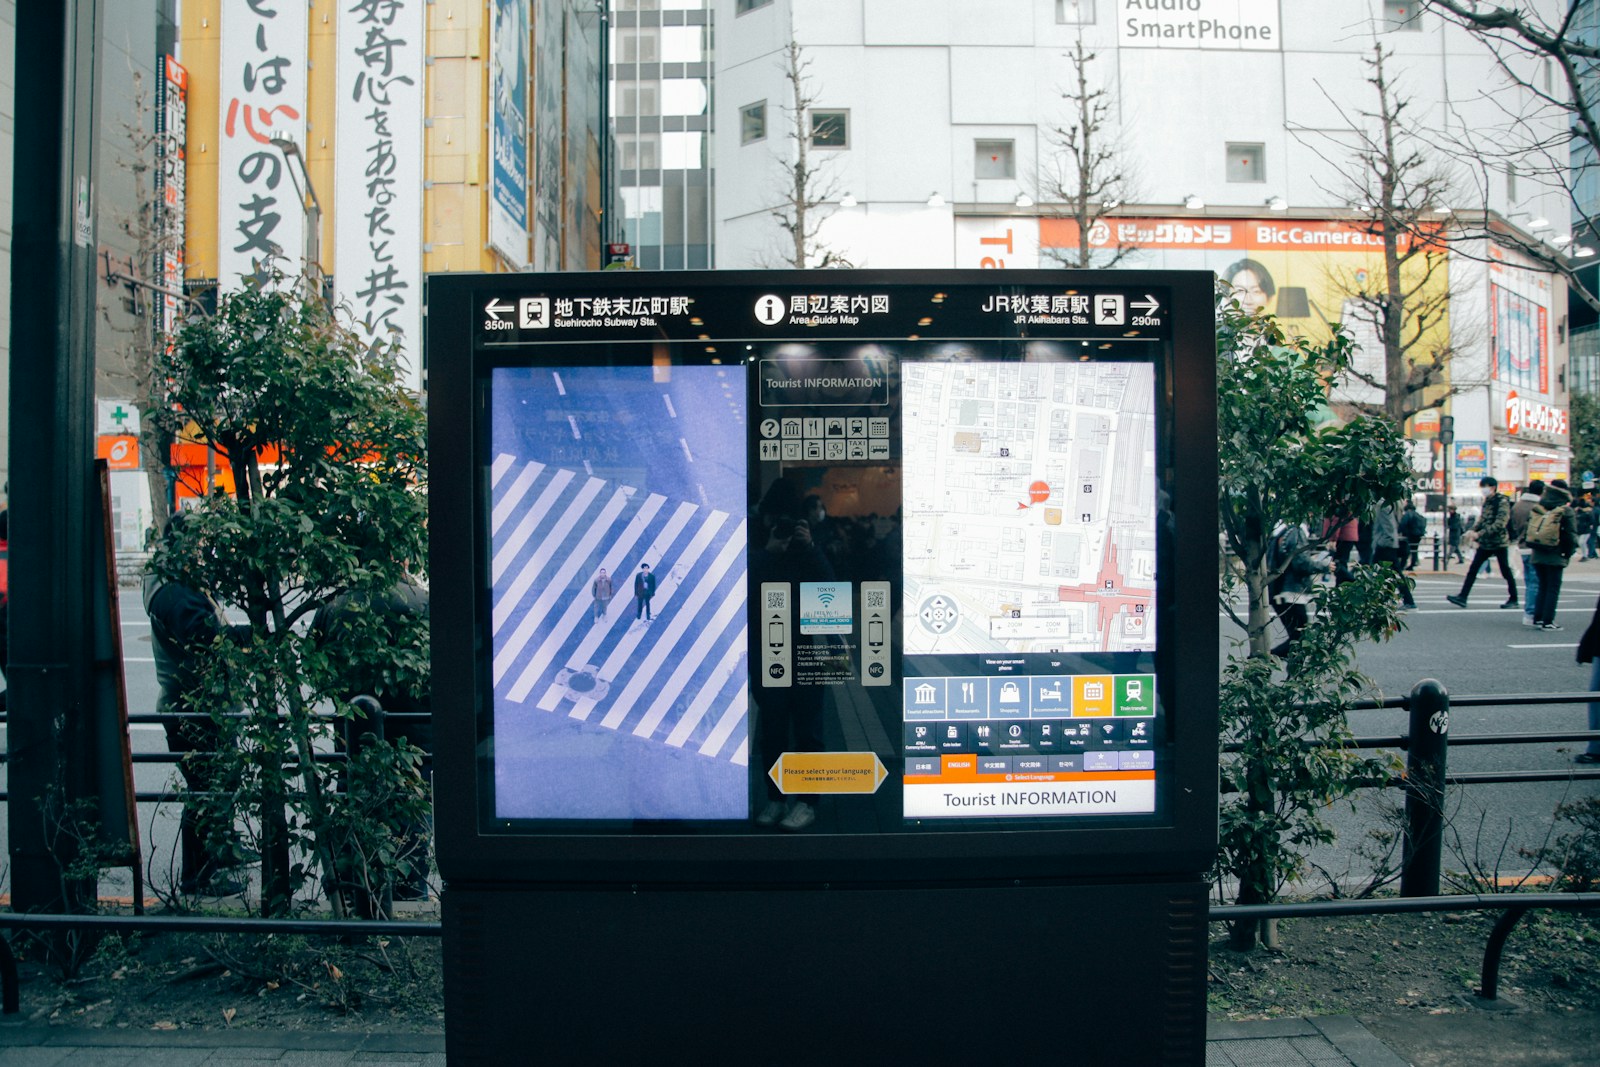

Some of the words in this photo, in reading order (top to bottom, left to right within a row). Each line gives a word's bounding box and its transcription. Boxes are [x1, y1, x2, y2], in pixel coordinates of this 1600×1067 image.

[554, 296, 690, 318] 地下鉄末広町駅
[788, 295, 890, 314] 周辺案内図
[981, 294, 1090, 314] JR秋葉原駅
[485, 319, 514, 331] 350m
[554, 317, 602, 328] Suehirocho
[604, 317, 638, 328] Subway
[640, 316, 658, 327] Sta.
[789, 314, 810, 325] Area
[812, 314, 838, 325] Guide
[840, 314, 859, 326] Map
[1013, 315, 1026, 325] JR
[1027, 314, 1071, 325] Akihabara
[1071, 314, 1089, 325] Sta.
[1131, 315, 1161, 327] 290m
[766, 378, 802, 388] Tourist
[804, 377, 882, 388] INFORMATION
[944, 792, 996, 807] Tourist
[1001, 790, 1117, 806] INFORMATION
